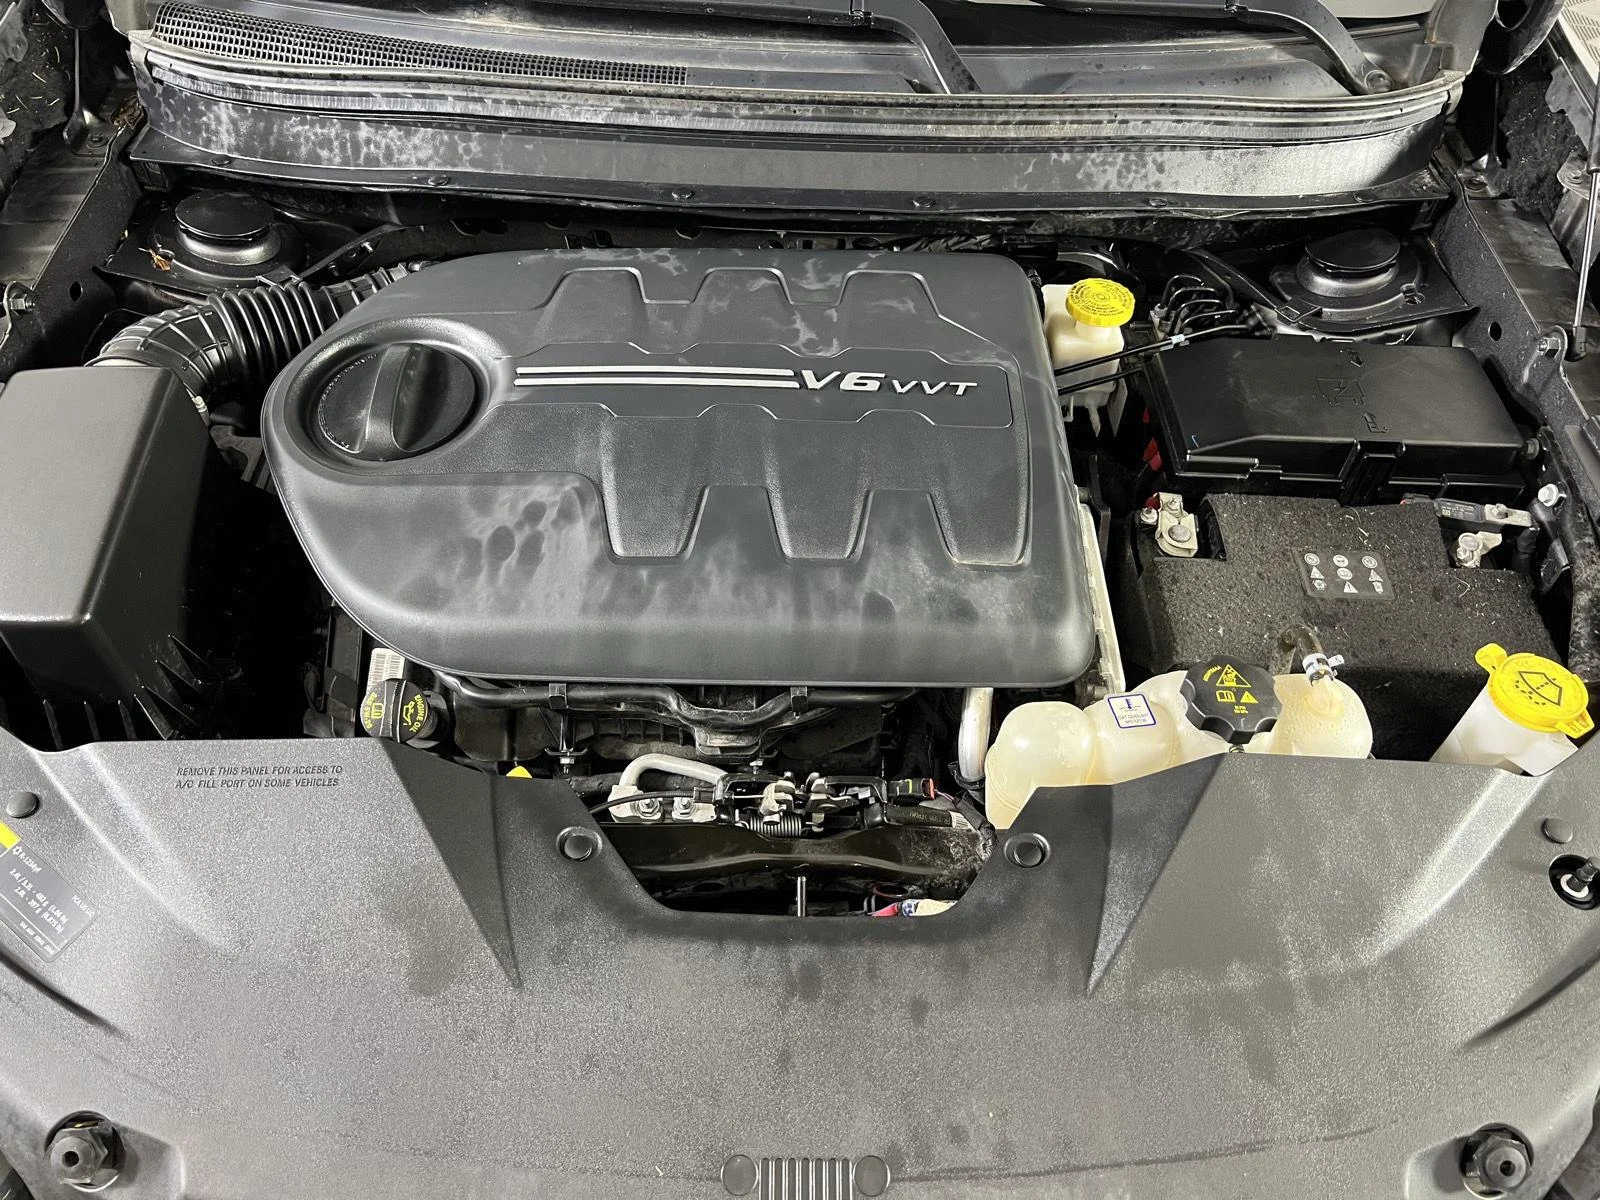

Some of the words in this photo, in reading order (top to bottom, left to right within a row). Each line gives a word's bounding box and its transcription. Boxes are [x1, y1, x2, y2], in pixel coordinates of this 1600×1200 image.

[801, 370, 886, 392] V6
[892, 380, 978, 396] VVT
[414, 694, 425, 721] ENGINE
[409, 721, 421, 733] OIL
[176, 766, 215, 776] REMOVE
[217, 766, 238, 776] THIS
[240, 766, 269, 775] PANEL
[271, 766, 291, 775] FOR
[292, 765, 328, 775] ACCESS
[330, 765, 343, 774] TO
[175, 780, 194, 789] A/C
[197, 780, 216, 788] FILL
[220, 780, 245, 788] PORT
[247, 779, 262, 788] ON
[264, 779, 292, 788] SOME
[294, 778, 339, 787] VEHICLES
